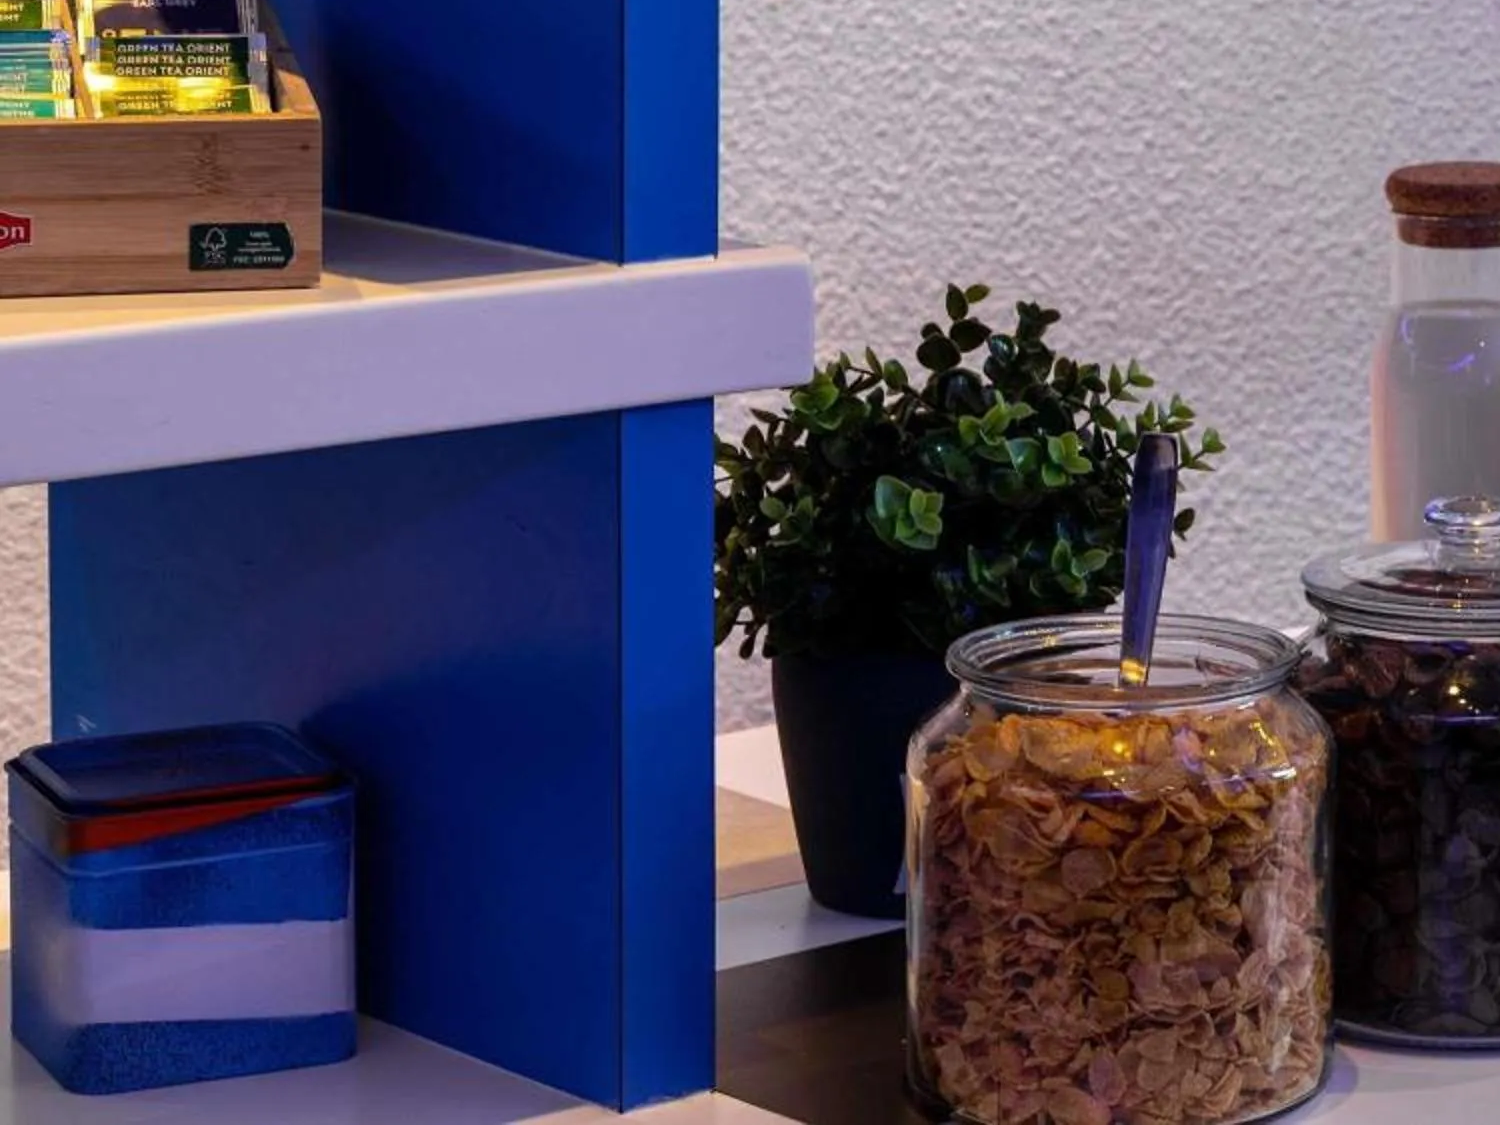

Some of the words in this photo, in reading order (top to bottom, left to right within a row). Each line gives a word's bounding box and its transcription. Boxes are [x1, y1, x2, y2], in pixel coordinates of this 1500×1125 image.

[117, 43, 158, 54] GREEN
[161, 43, 184, 53] TEA
[186, 43, 231, 53] ORIENT
[116, 56, 158, 65] GREEN
[160, 55, 184, 65] TEA
[186, 55, 231, 65] ORIENT
[116, 66, 158, 77] GREEN
[159, 66, 183, 77] TEA
[185, 66, 230, 77] ORIENT
